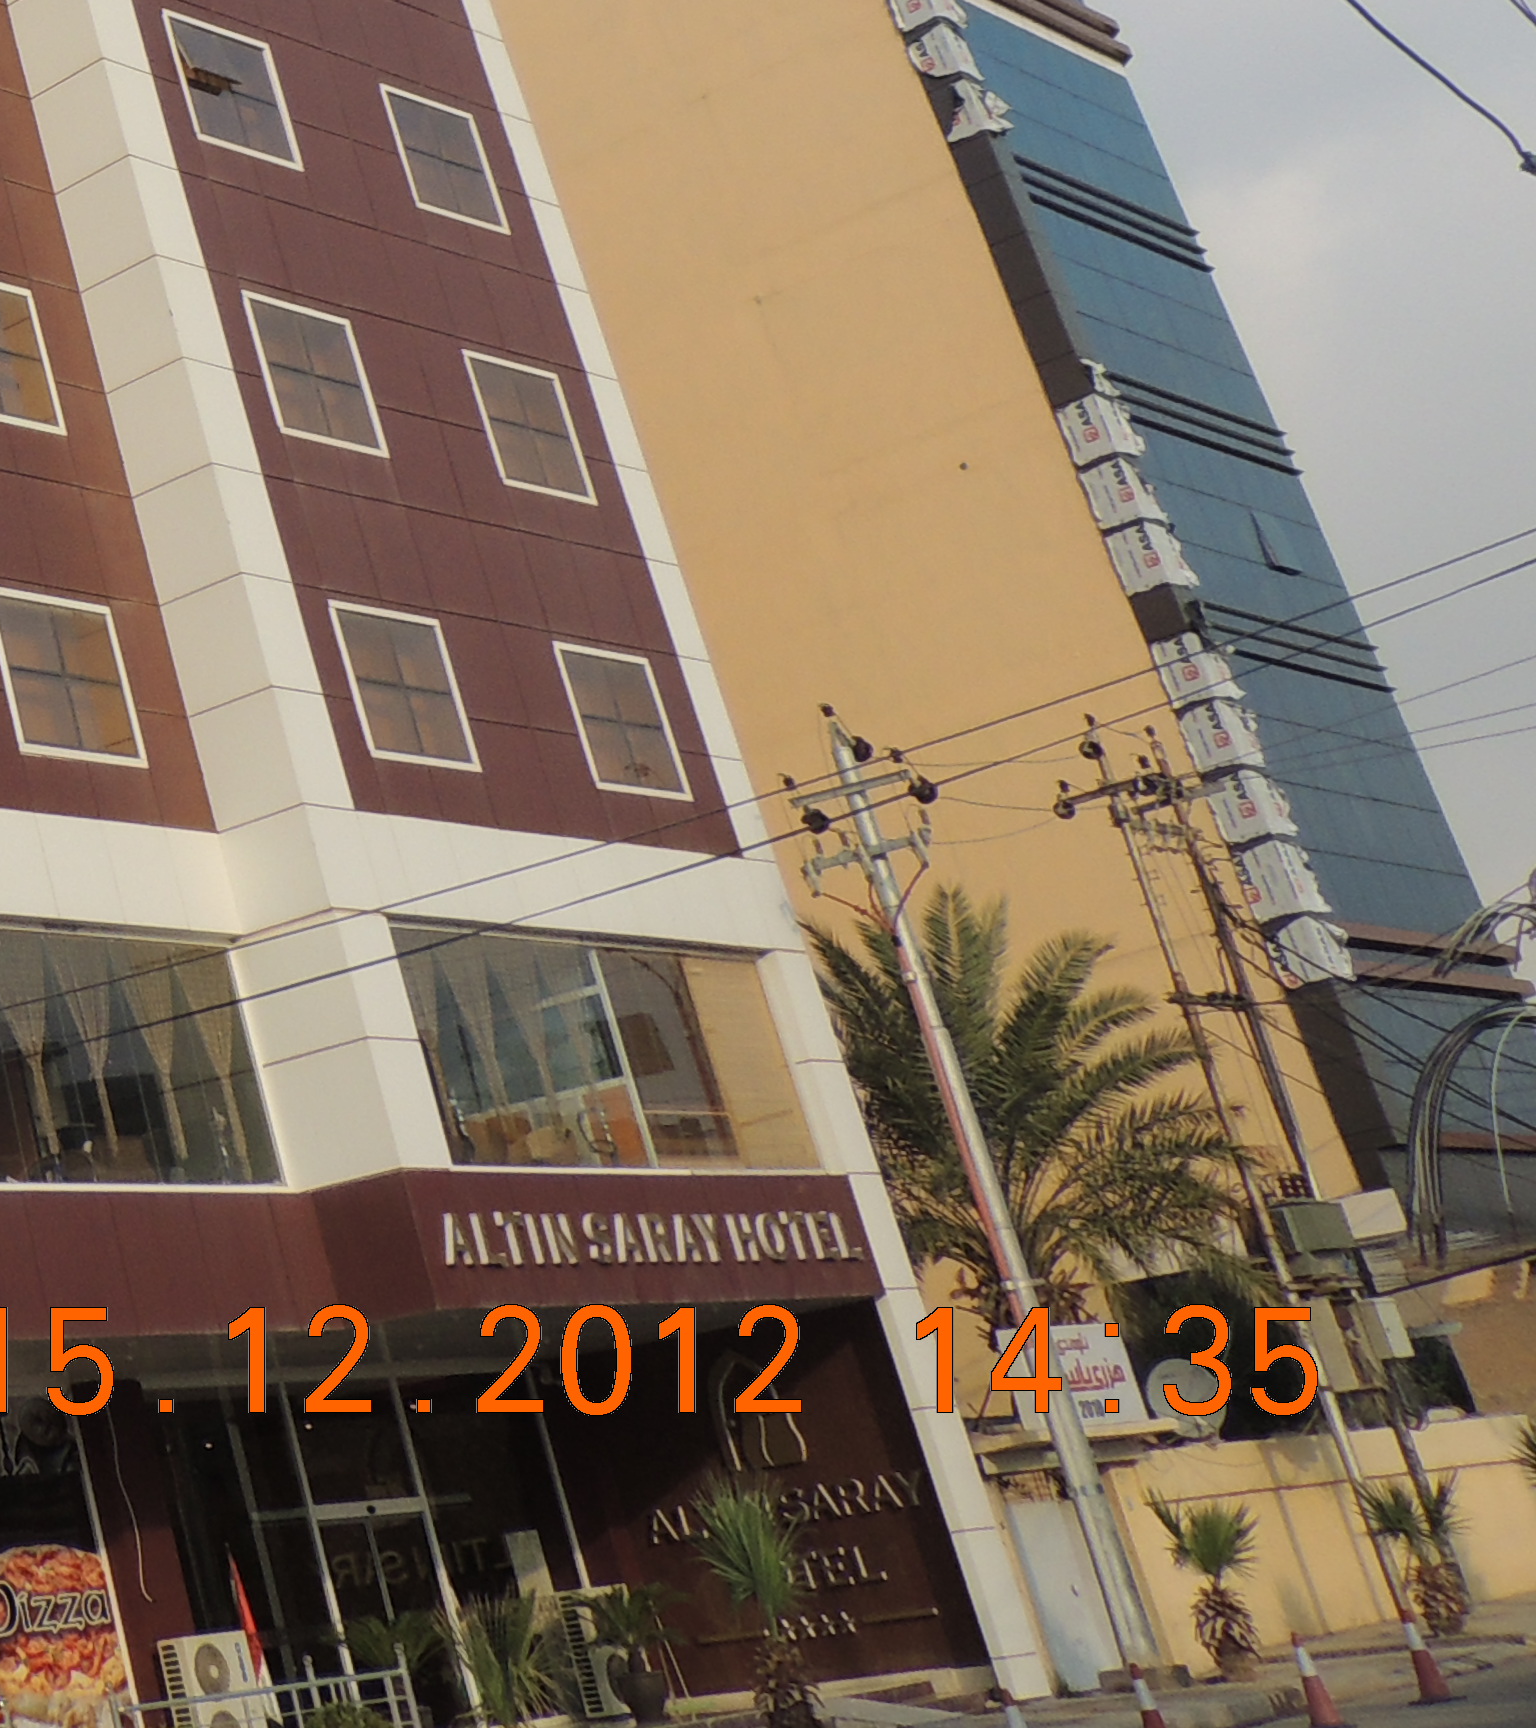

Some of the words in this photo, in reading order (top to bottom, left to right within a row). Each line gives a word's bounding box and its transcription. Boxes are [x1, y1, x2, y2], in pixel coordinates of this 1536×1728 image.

[442, 1211, 578, 1266] ALTIN
[583, 1211, 723, 1264] SARAY
[728, 1210, 863, 1262] HOTEL
